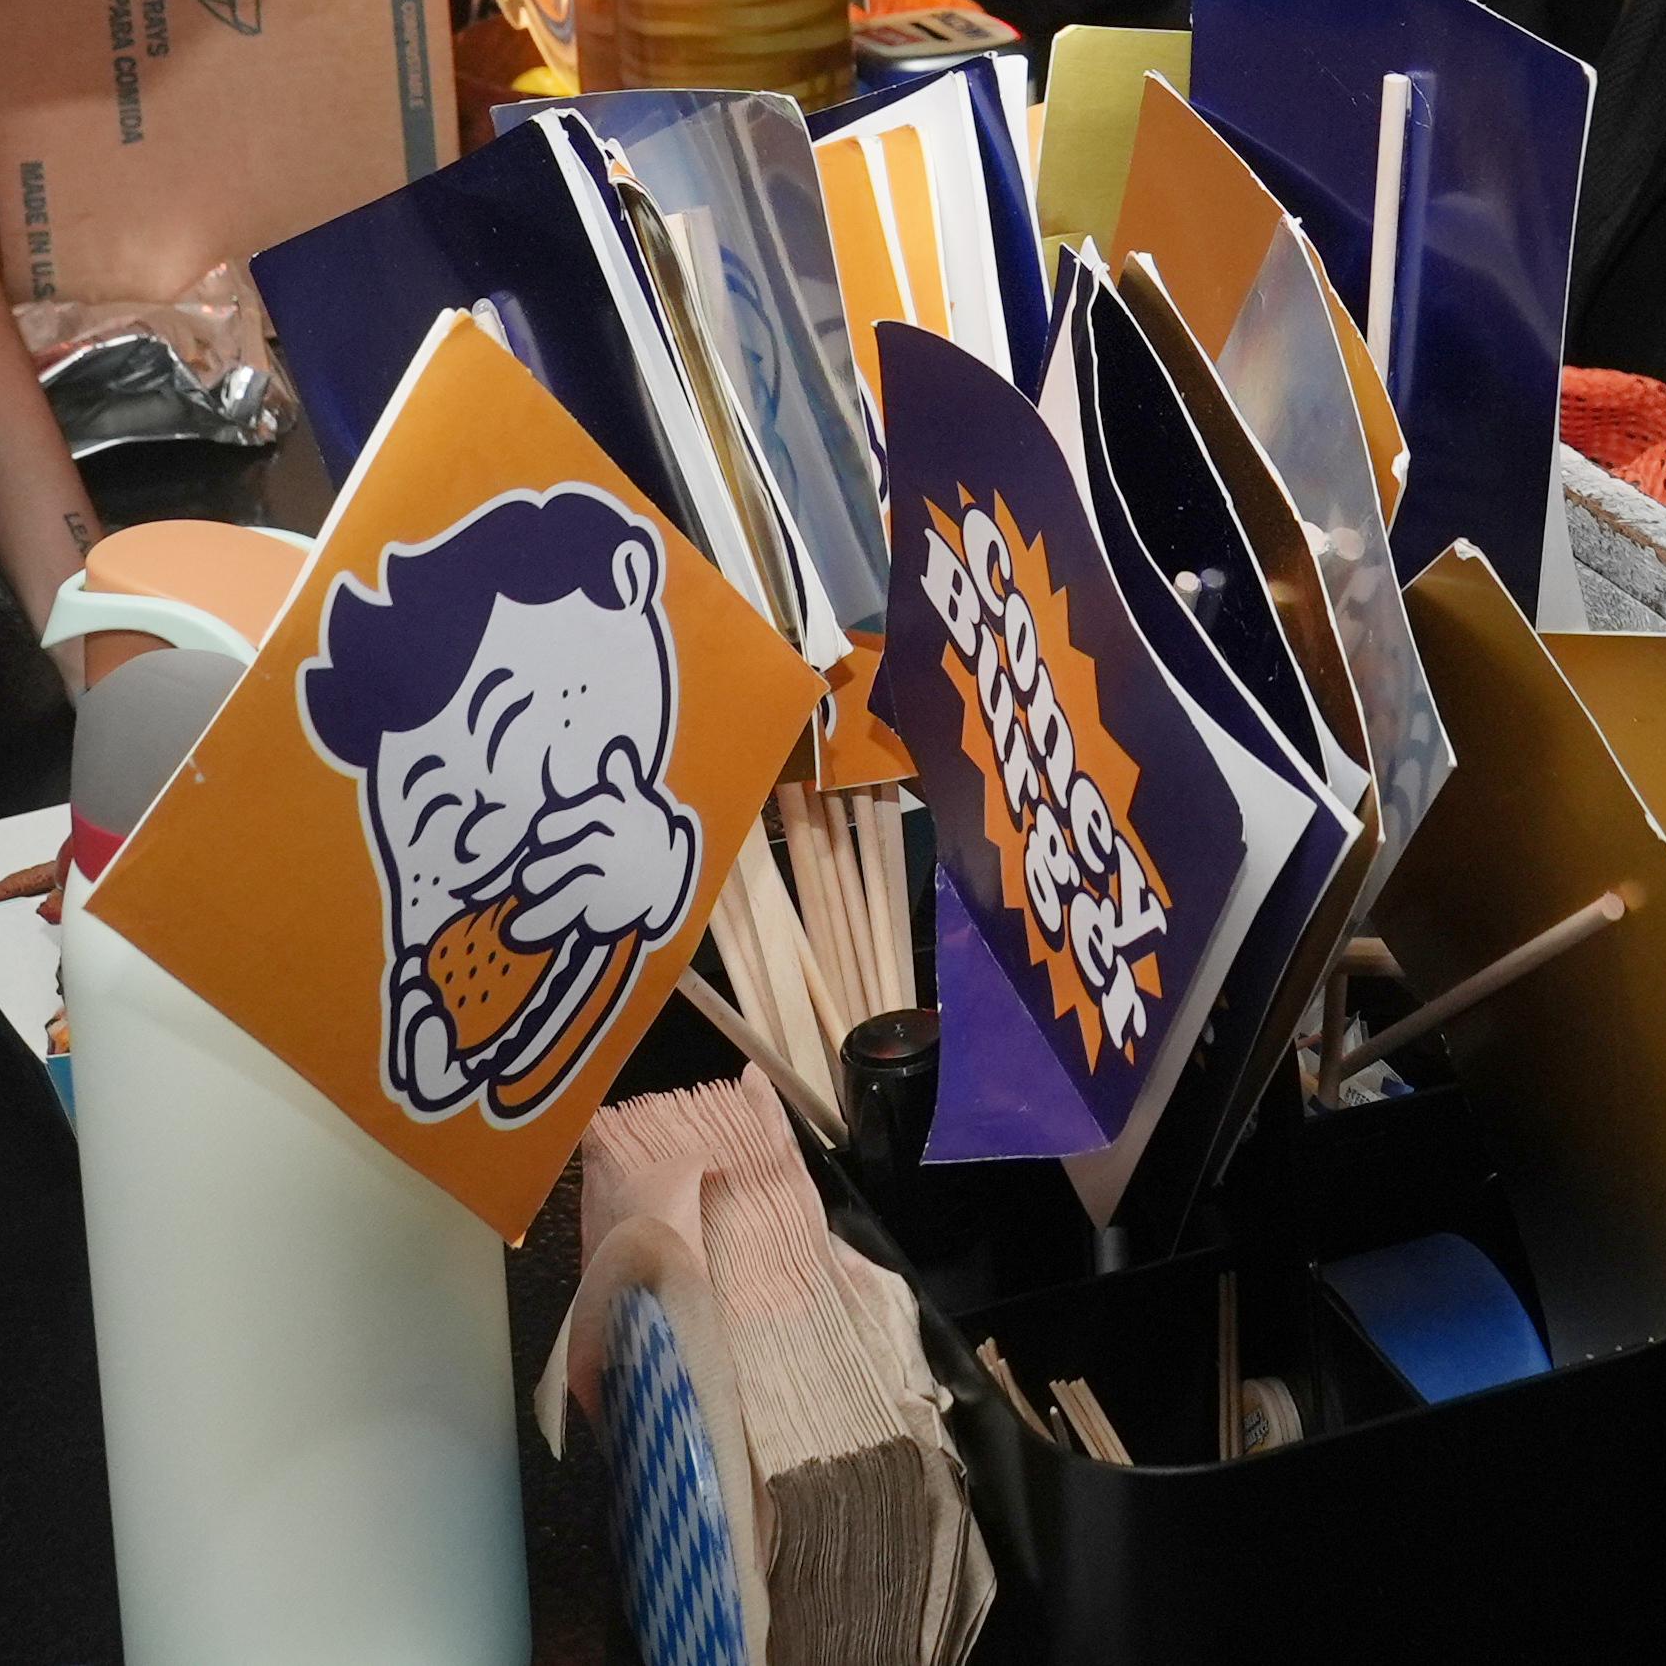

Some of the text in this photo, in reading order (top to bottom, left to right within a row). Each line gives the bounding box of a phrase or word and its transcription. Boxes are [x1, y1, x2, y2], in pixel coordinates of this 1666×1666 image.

[114, 55, 145, 146] COMIDA
[20, 160, 49, 226] MADE
[28, 230, 53, 255] IN
